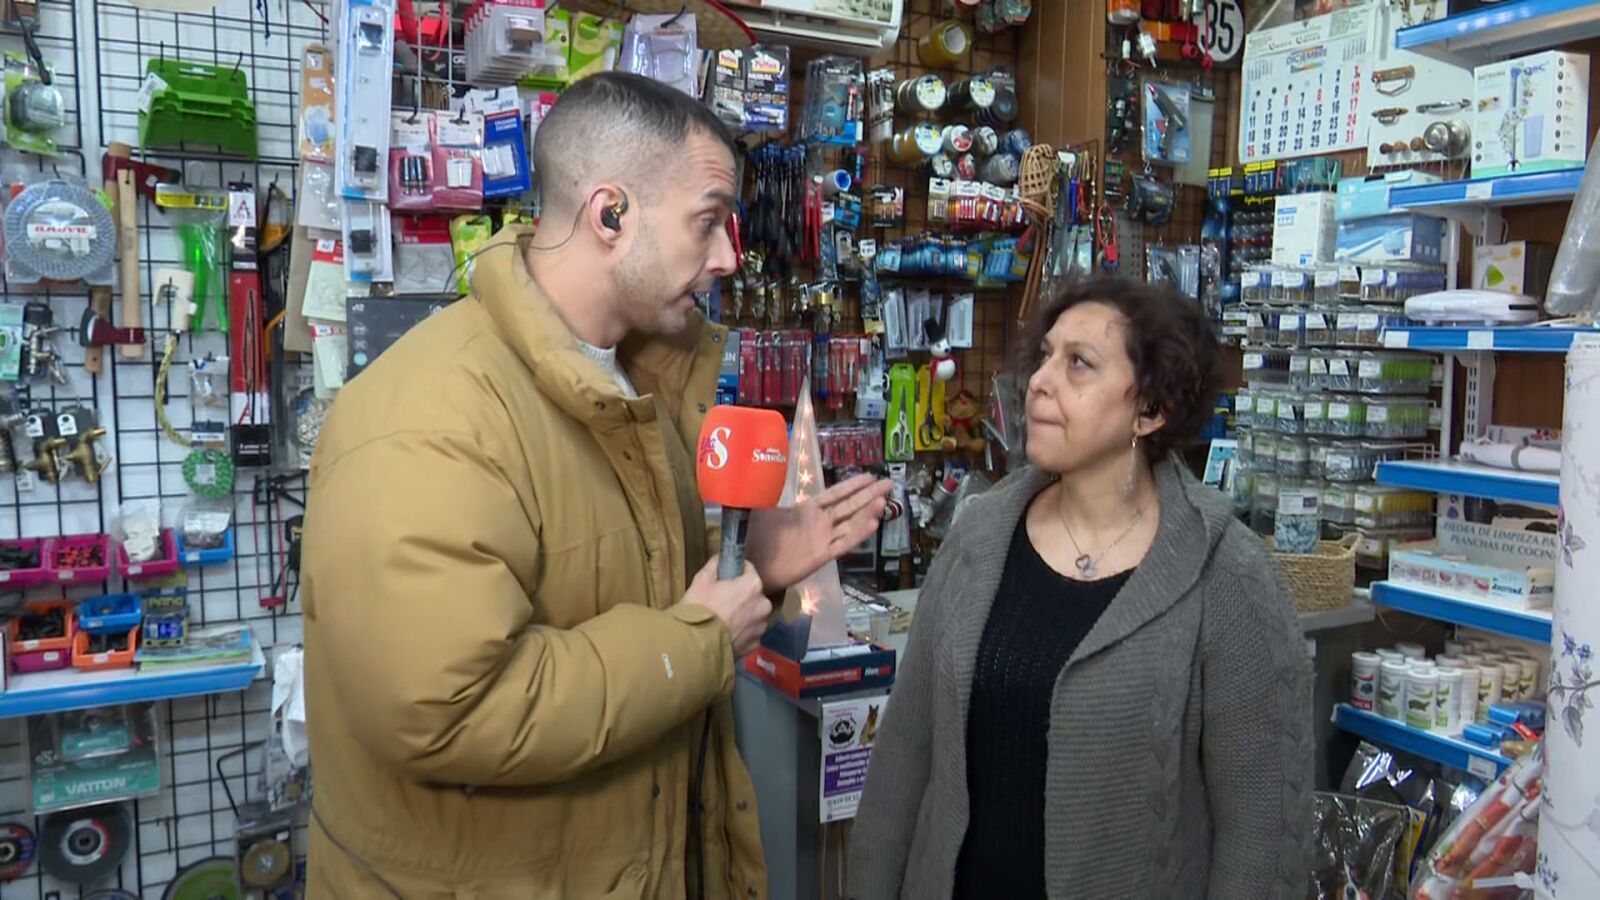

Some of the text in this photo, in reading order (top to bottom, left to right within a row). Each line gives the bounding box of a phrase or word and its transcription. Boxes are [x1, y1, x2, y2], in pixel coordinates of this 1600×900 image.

[1200, 0, 1235, 54] 35
[1286, 47, 1328, 66] DICIEMBRE
[1351, 81, 1360, 94] 10
[1249, 97, 1358, 128] 11 12 13 14 15 16 17
[1248, 113, 1357, 142] 18 19 20 21 22 23 24
[1247, 129, 1354, 157] 25 26 27 28 29 30 31
[706, 426, 732, 470] S
[1443, 521, 1475, 535] PIEDRA
[1478, 527, 1491, 538] DE
[1493, 529, 1538, 544] LIMPIEZA
[1450, 533, 1556, 560] PLANCHAS DE COCIN
